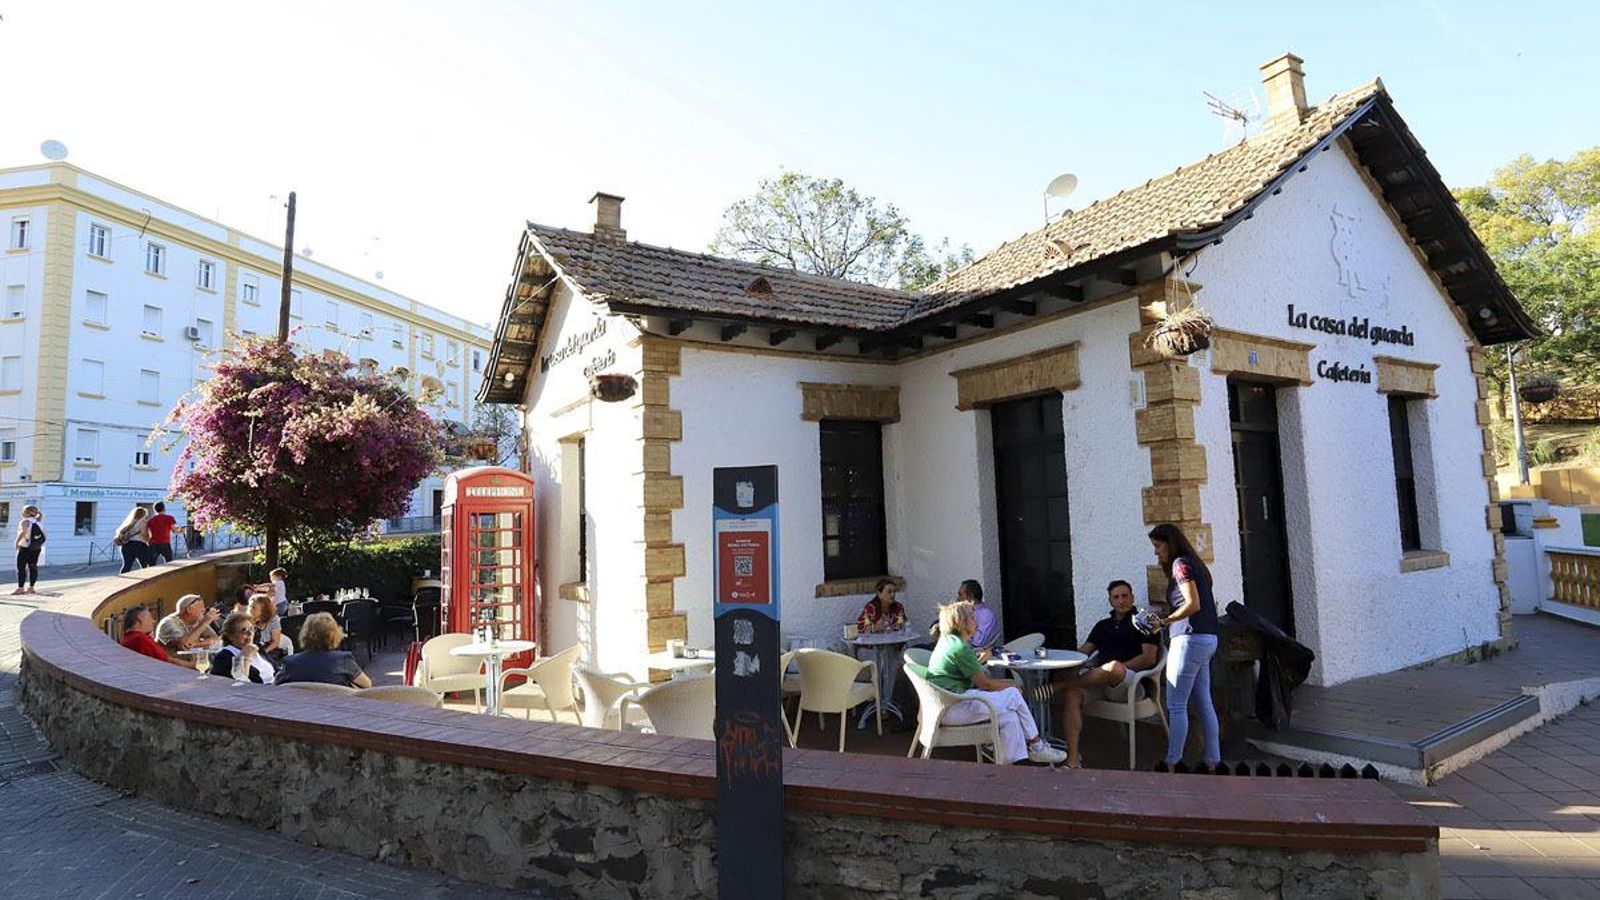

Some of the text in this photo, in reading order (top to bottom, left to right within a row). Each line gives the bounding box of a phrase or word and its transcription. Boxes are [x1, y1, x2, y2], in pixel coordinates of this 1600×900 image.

[1287, 304, 1415, 347] La casa del guarda
[1316, 359, 1372, 385] Cafetería
